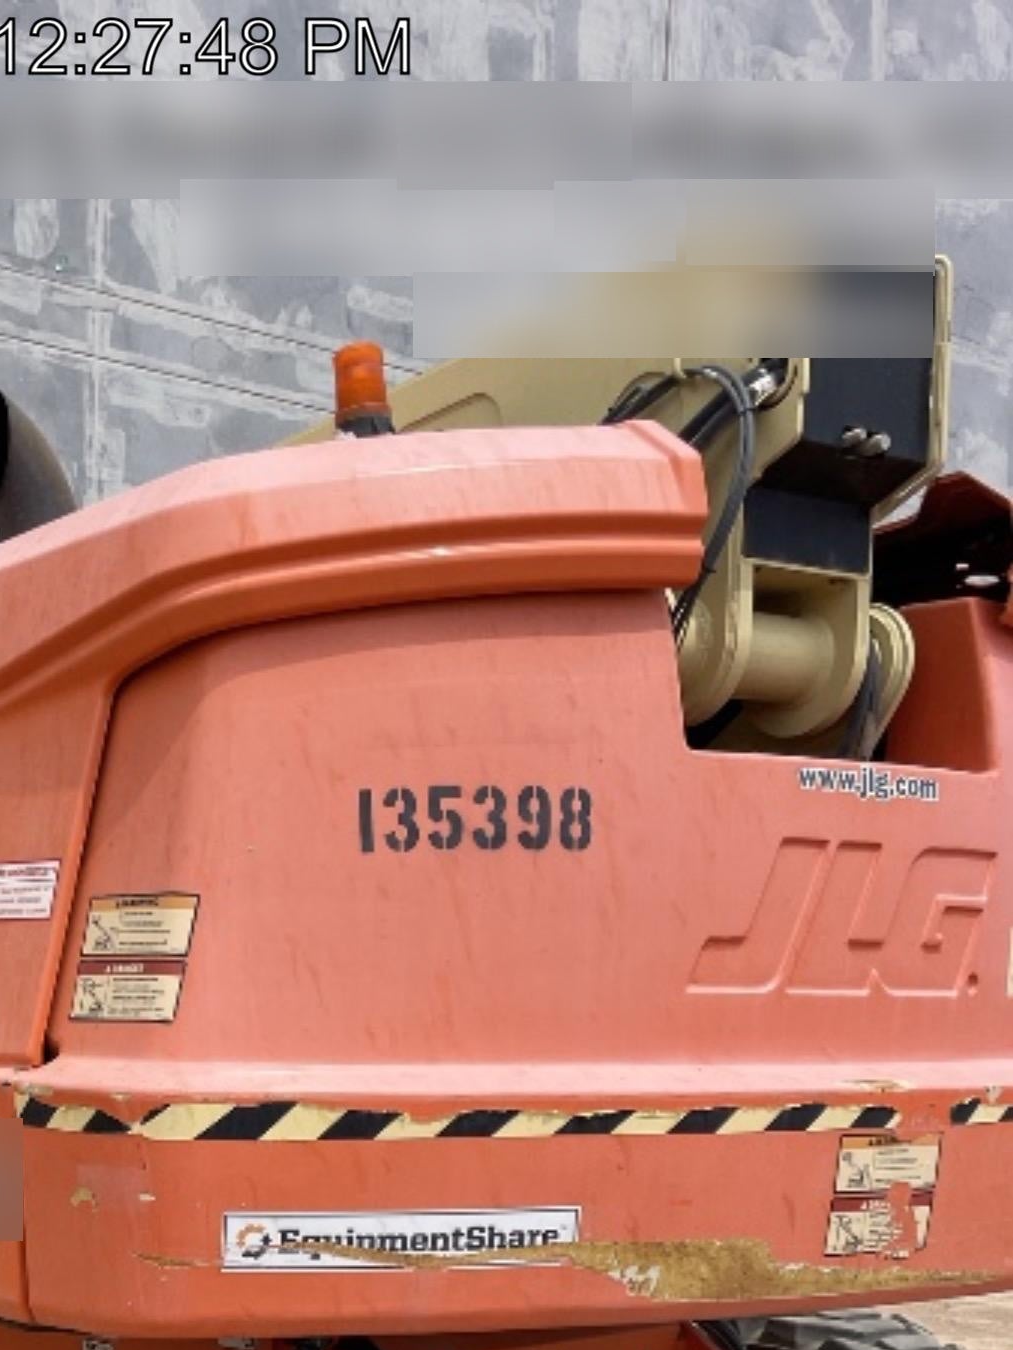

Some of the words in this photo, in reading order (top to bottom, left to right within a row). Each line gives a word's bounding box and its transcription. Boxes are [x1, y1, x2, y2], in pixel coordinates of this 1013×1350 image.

[799, 768, 937, 799] www.jlg.com
[358, 785, 592, 853] 135398
[686, 836, 998, 998] JLG
